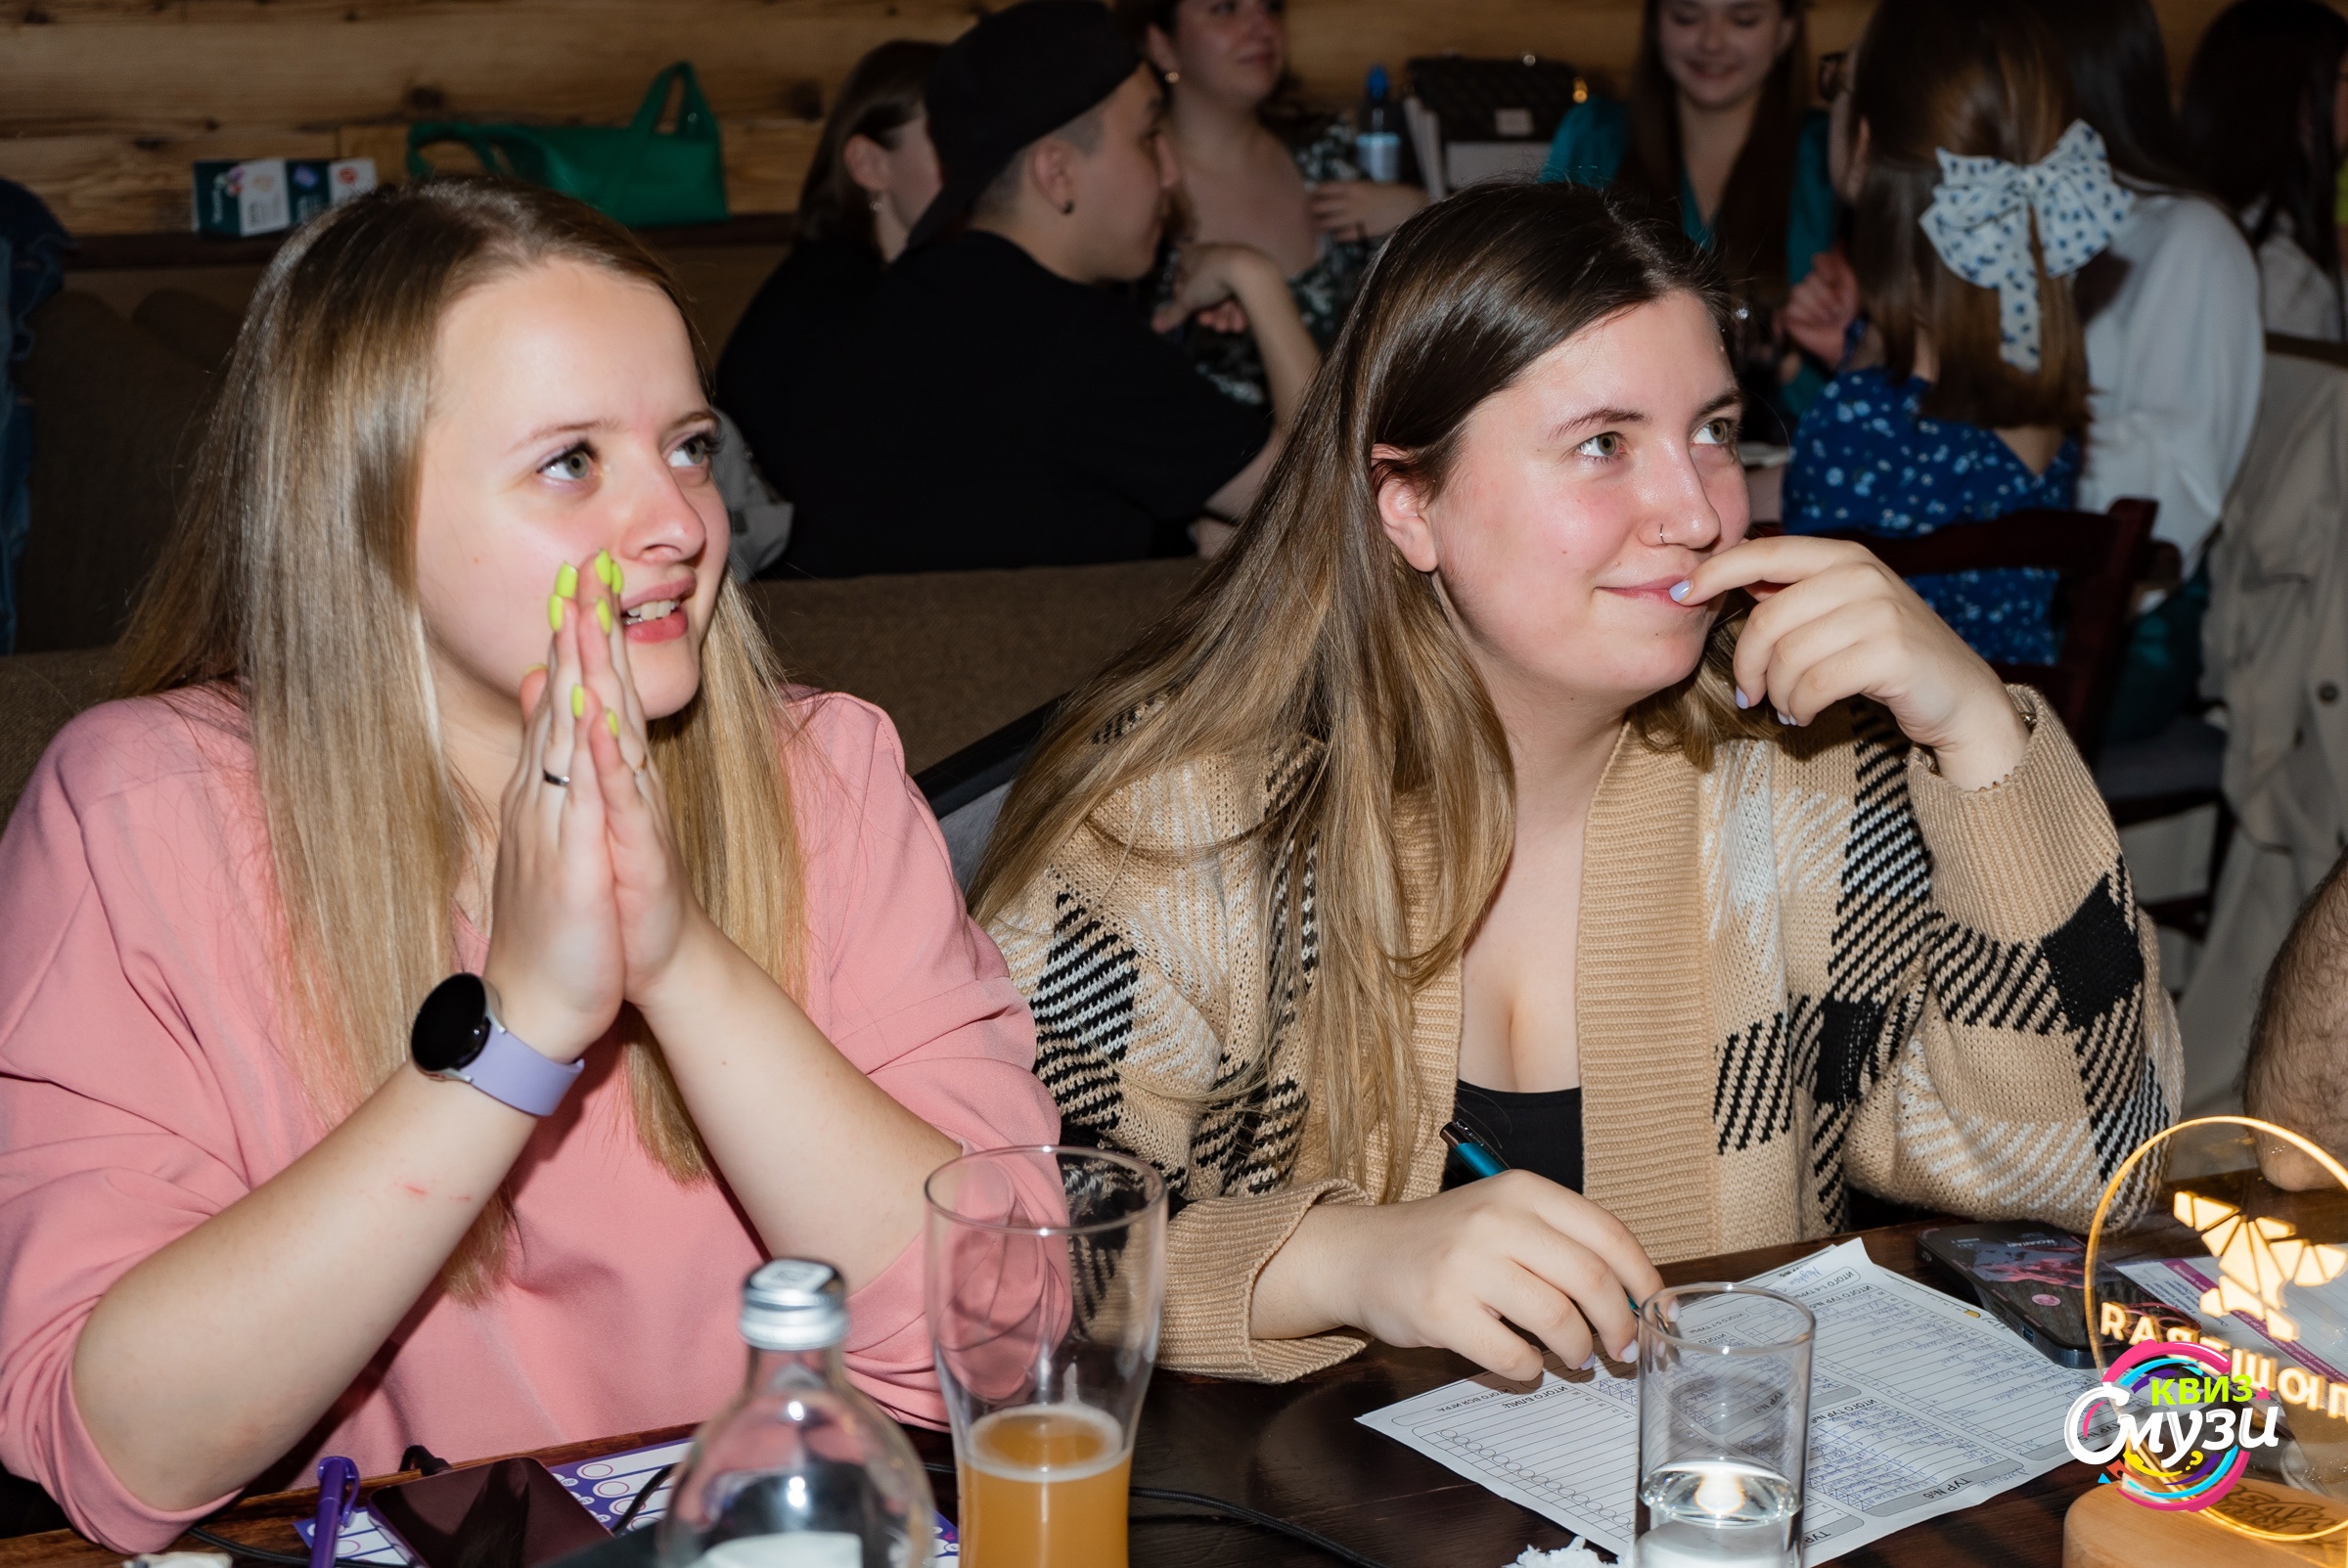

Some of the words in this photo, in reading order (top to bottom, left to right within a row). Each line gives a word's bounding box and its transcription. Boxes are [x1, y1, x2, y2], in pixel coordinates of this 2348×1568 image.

[1821, 1271, 1860, 1286] ИТОГО
[1838, 1283, 1874, 1298] ИТОГО
[1822, 1294, 1844, 1304] ТУР
[1533, 1385, 1567, 1401] ИТОГО
[1768, 1391, 1784, 1405] ТУР
[1752, 1402, 1771, 1413] №7
[1841, 1397, 1878, 1412] ИТОГО
[1824, 1408, 1847, 1418] ТУР
[1947, 1477, 1972, 1491] ТУР
[1922, 1487, 1946, 1499] №6
[1804, 1529, 1831, 1544] ТУР
